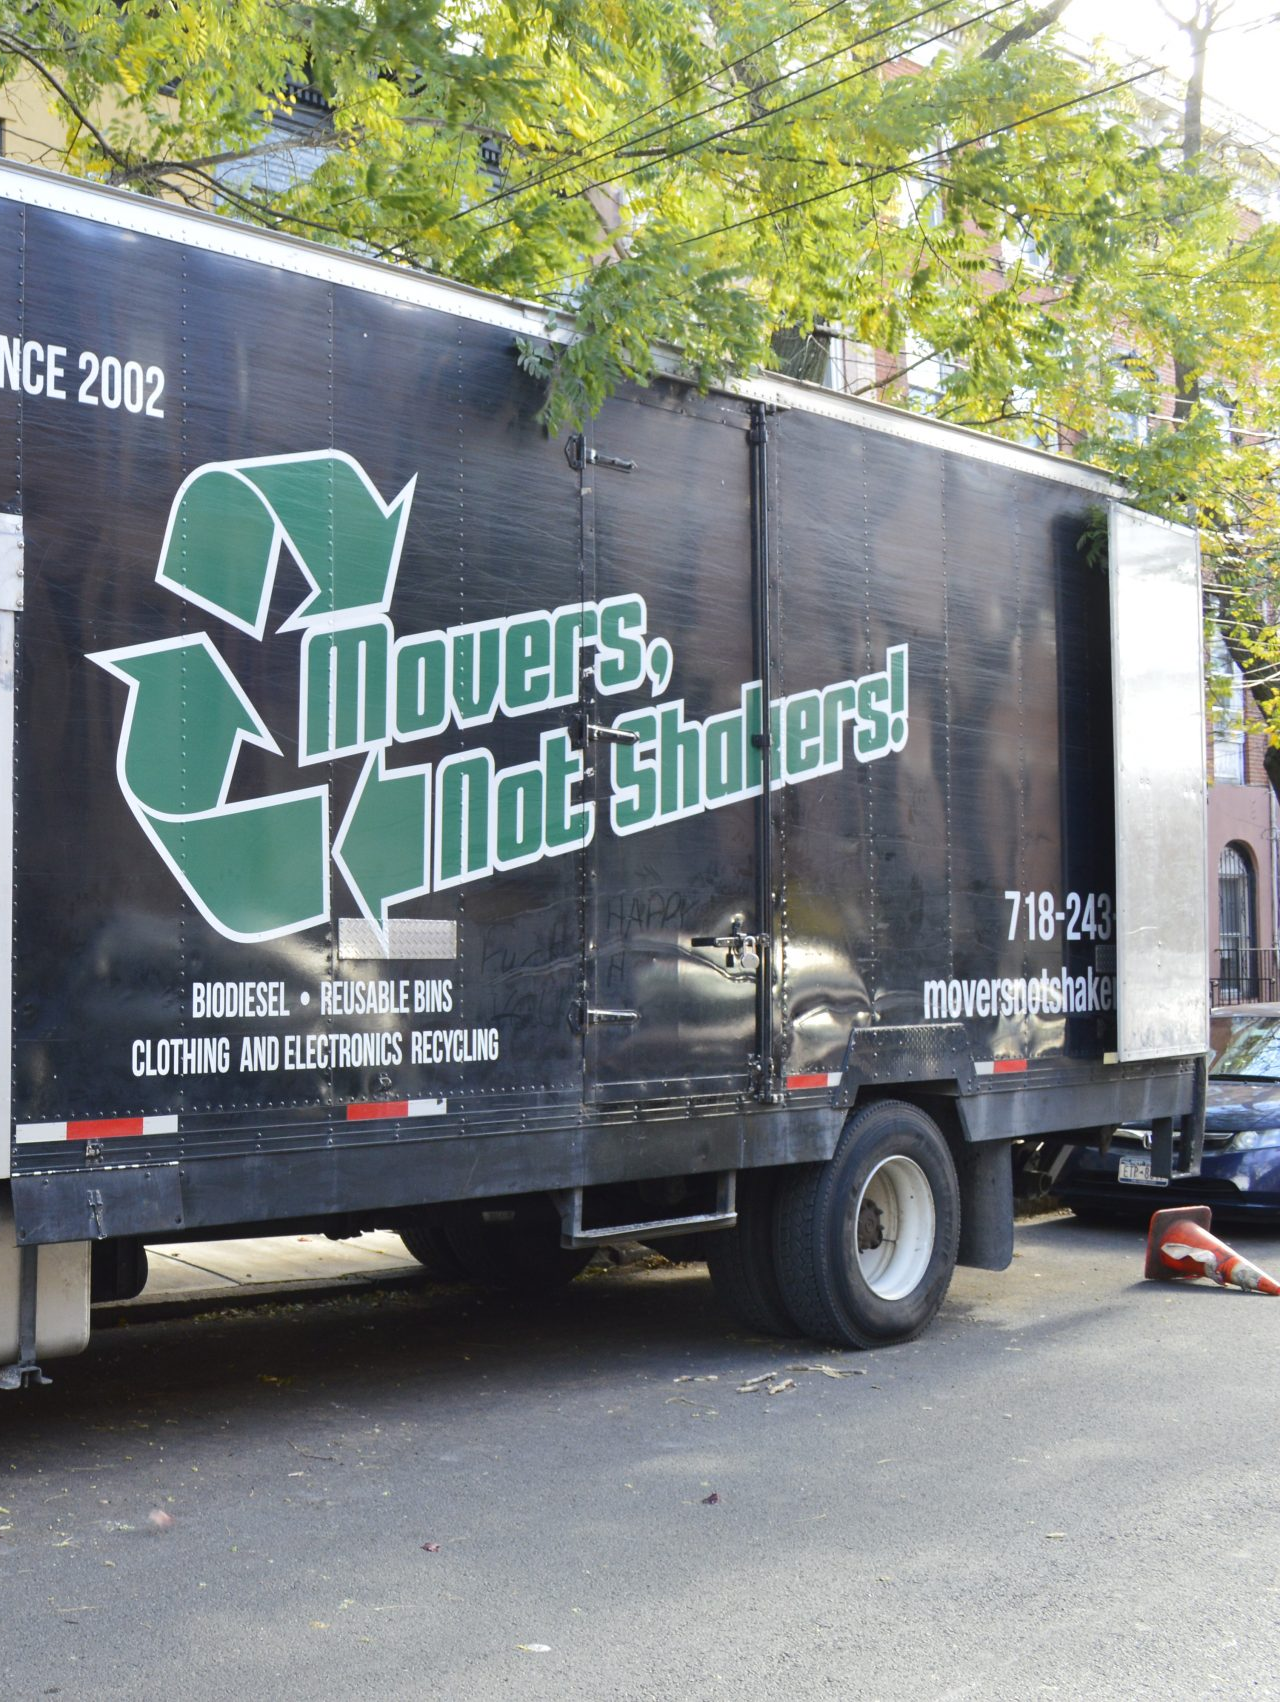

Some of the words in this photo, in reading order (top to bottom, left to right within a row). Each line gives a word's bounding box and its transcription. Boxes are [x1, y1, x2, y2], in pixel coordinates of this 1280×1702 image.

[78, 351, 166, 418] 2002
[298, 593, 673, 767] Movers,
[433, 728, 596, 892] Not
[610, 643, 909, 836] Shakers!
[192, 982, 290, 1018] BIODIESEL
[320, 980, 410, 1015] REUSABLE
[414, 979, 453, 1013] BINS
[132, 1037, 231, 1077] CLOTHING
[239, 1035, 280, 1072] AND
[284, 1032, 403, 1070] ELECTRONICS
[411, 1028, 500, 1065] RECYCLING
